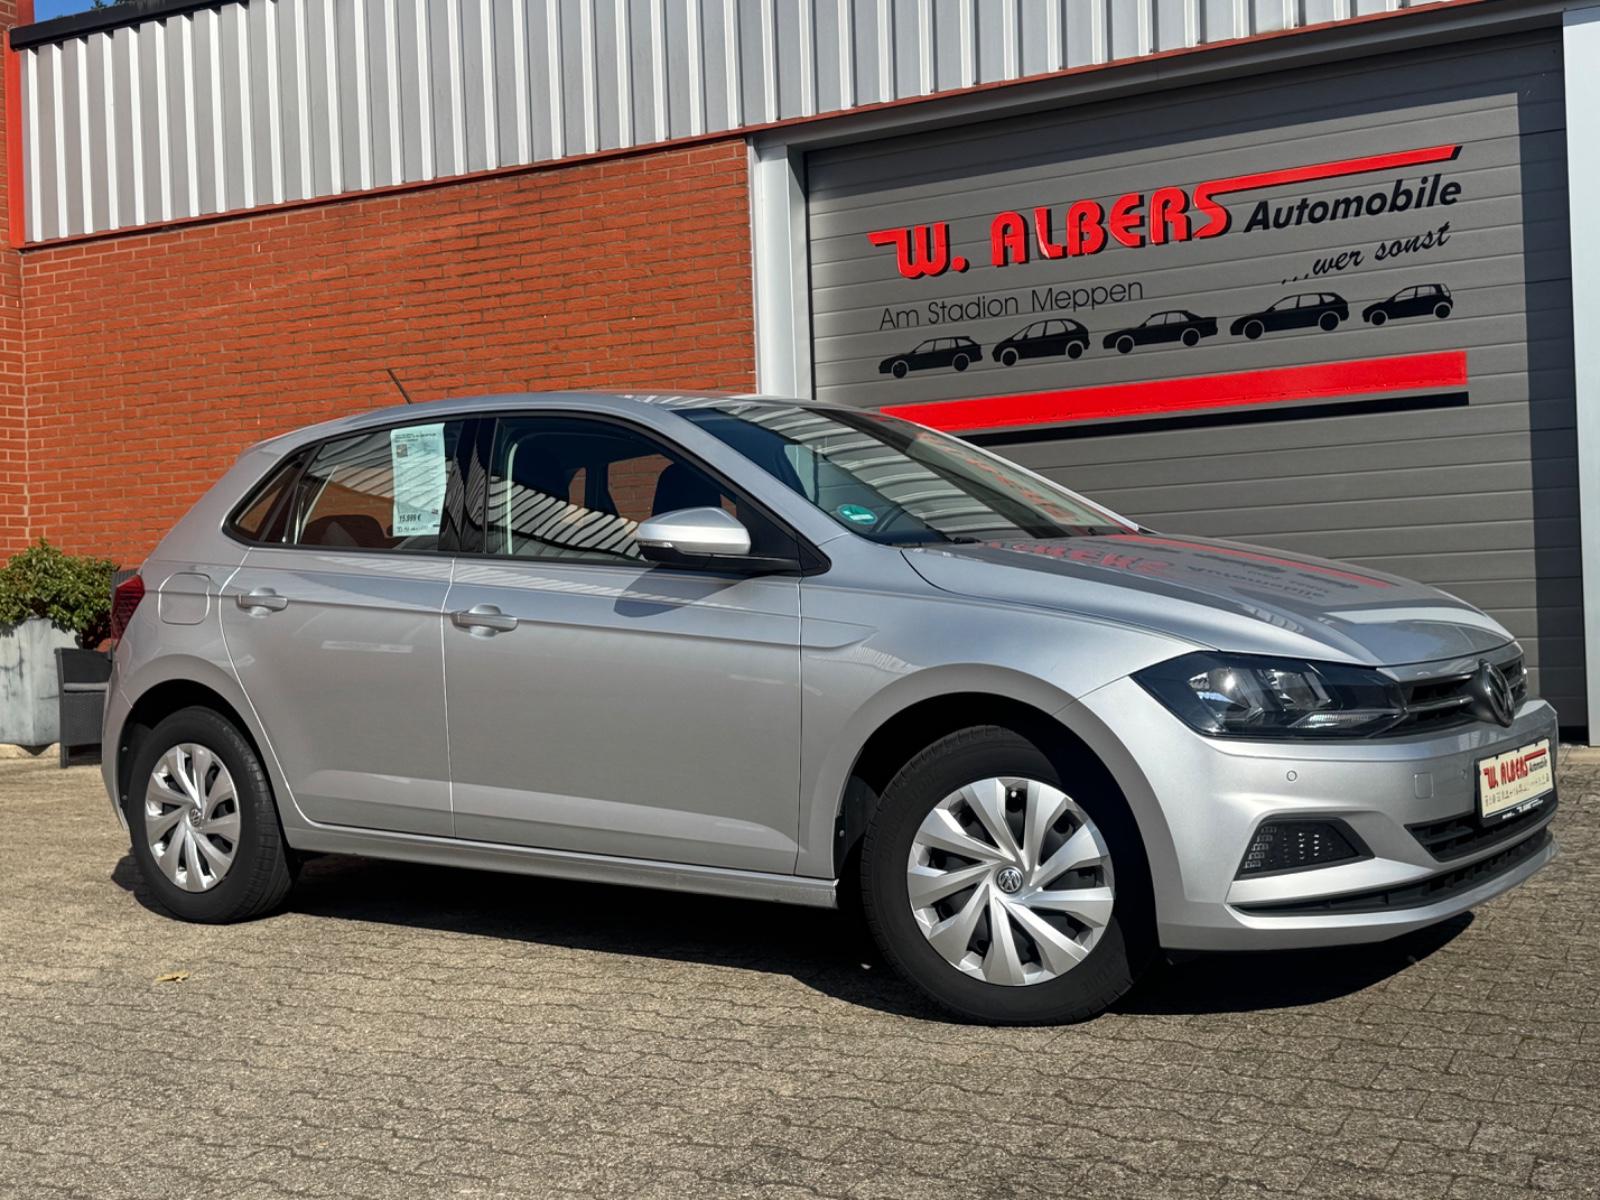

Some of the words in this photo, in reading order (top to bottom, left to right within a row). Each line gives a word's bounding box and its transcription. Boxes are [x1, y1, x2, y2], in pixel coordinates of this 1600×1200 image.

[867, 221, 970, 280] W.
[990, 181, 1232, 268] ALBERS
[1243, 173, 1461, 233] Automobile
[1375, 221, 1451, 261] sonst
[879, 308, 919, 331] Am
[928, 295, 1018, 323] Stadion
[1032, 280, 1143, 312] Meppen
